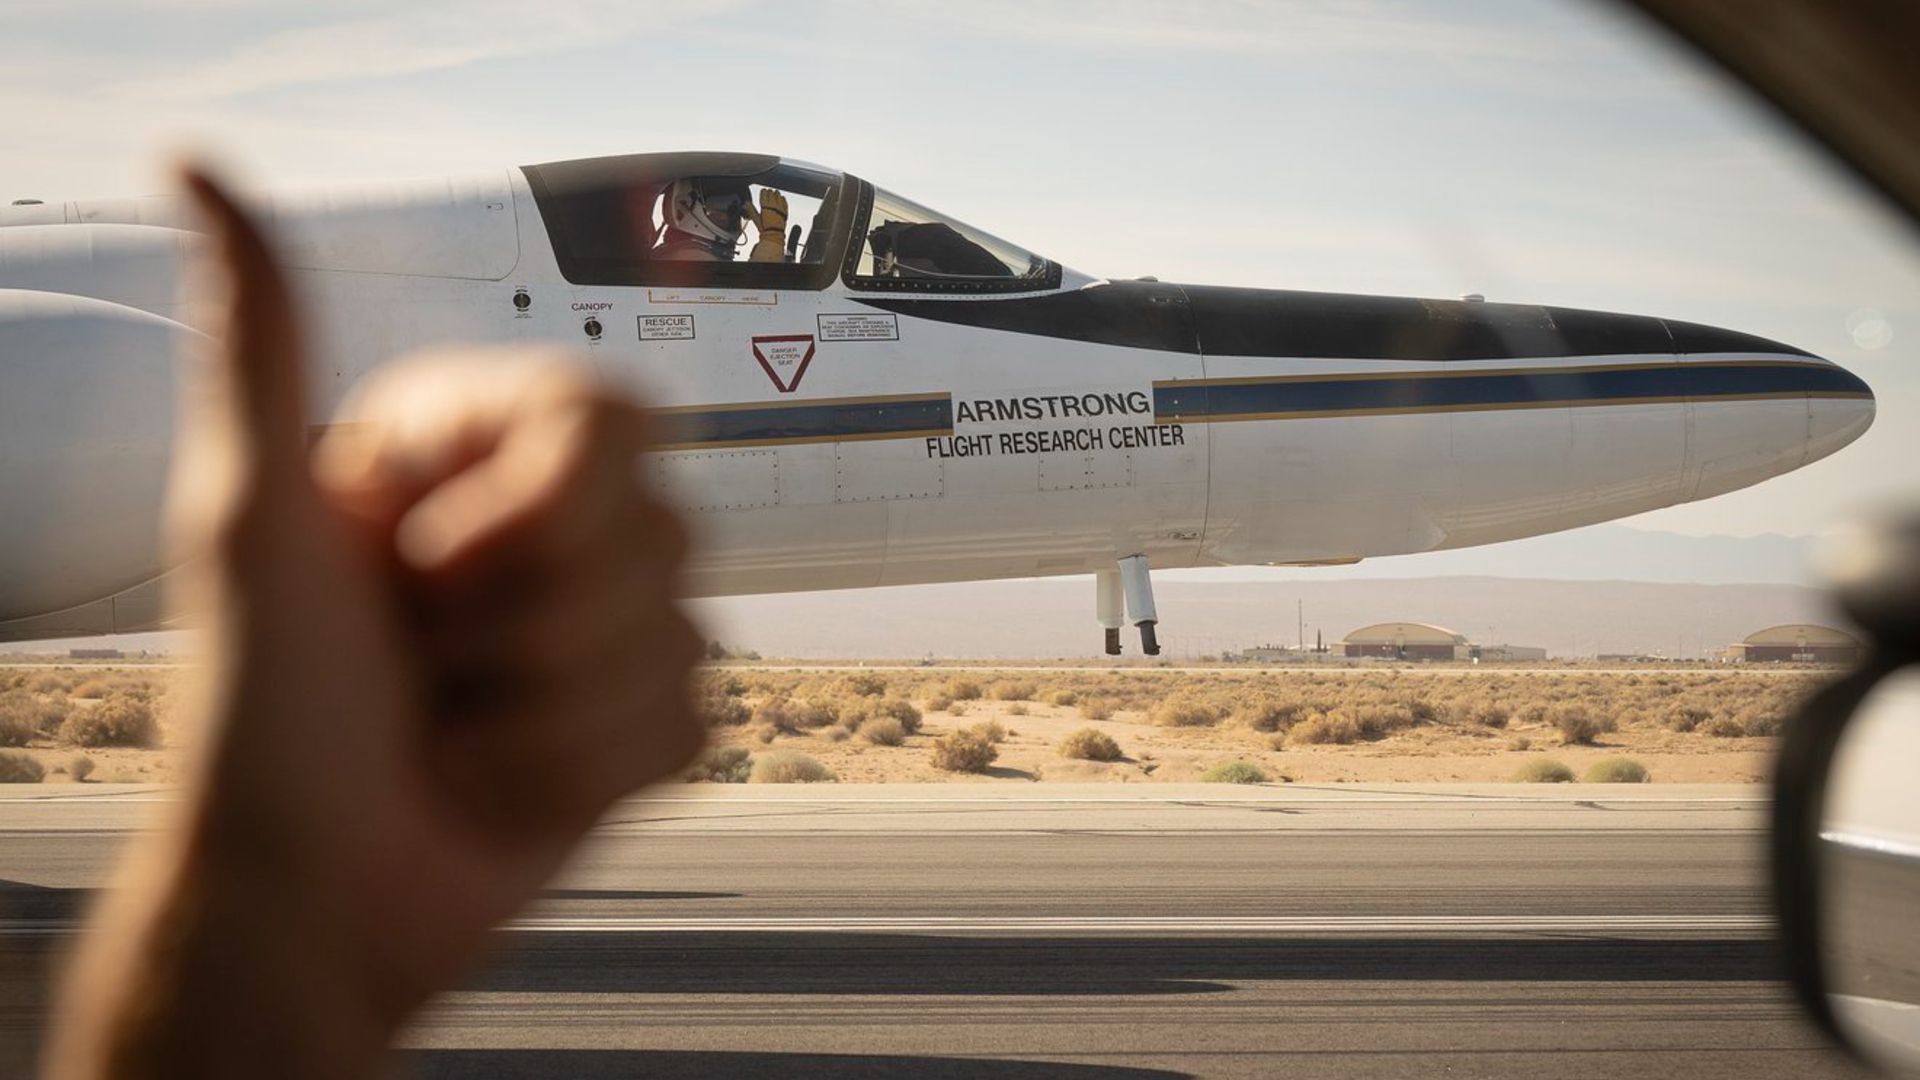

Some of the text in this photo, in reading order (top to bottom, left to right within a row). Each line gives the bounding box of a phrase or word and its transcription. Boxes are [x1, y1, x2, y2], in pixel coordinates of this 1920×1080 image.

[571, 303, 613, 312] CANOPY
[645, 317, 688, 327] RESCUE
[957, 391, 1150, 423] ARMSTRONG
[926, 424, 1185, 458] FLIGHT RESEARCH CENTER
